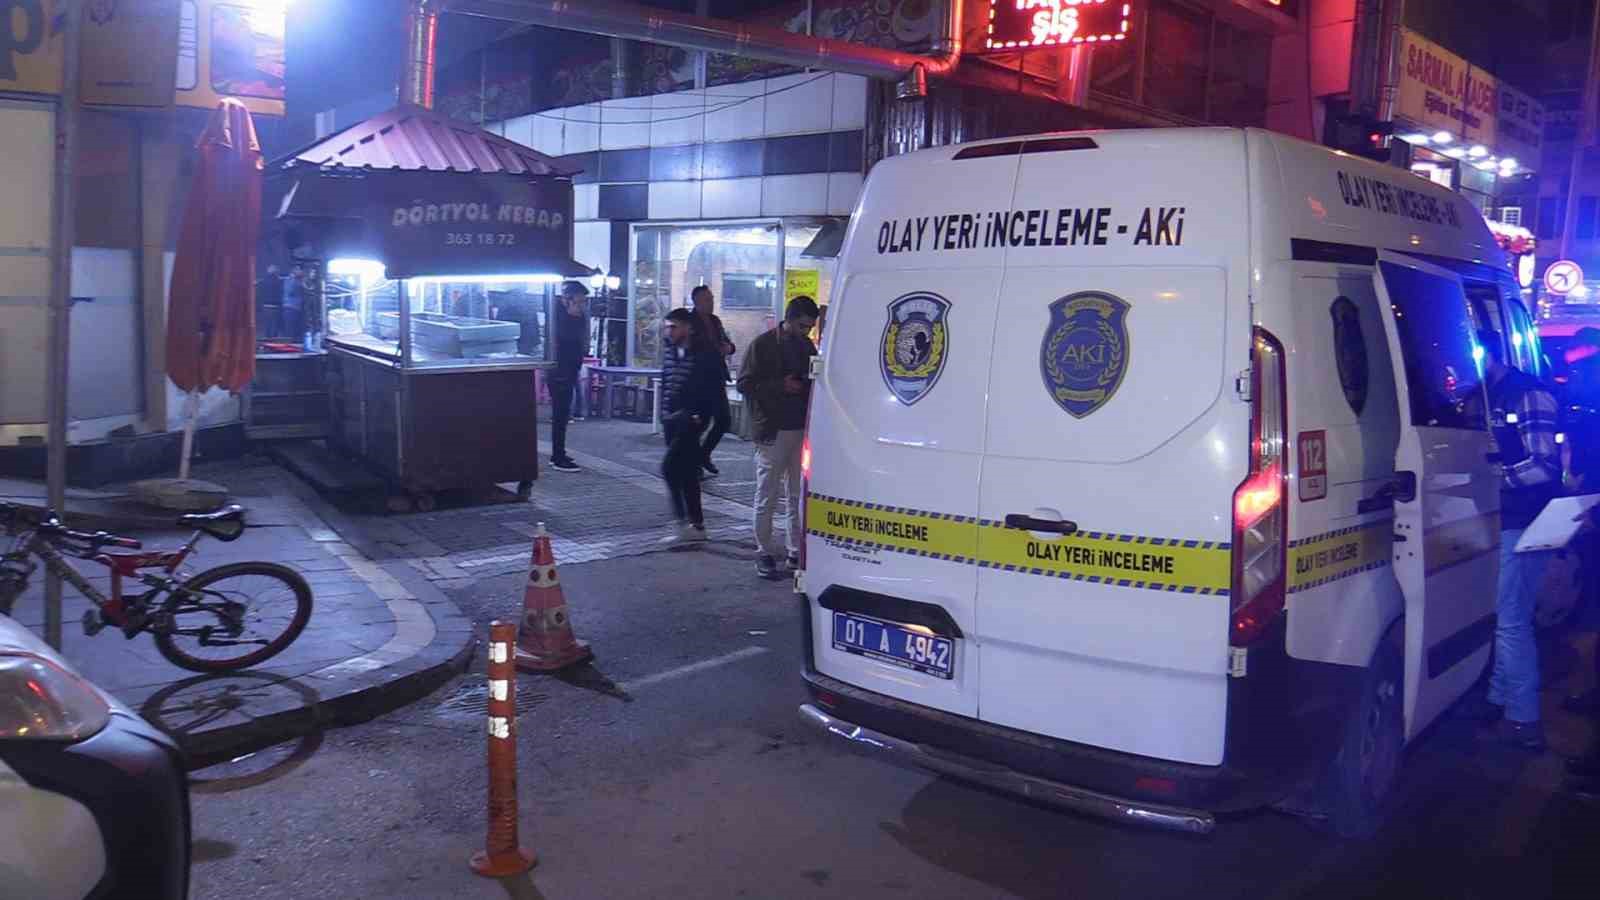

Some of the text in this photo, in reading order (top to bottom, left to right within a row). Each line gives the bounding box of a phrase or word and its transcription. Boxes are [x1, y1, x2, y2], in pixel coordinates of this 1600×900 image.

[1406, 43, 1455, 98] SARMAL
[392, 199, 564, 228] DÖRTYOL KEBAP
[447, 232, 516, 245] 363 18 72
[877, 216, 929, 254] OLAY
[1301, 438, 1324, 472] 112
[827, 510, 850, 527] OLAY
[1027, 541, 1062, 562] OLAY
[846, 619, 864, 646] 01
[880, 628, 890, 653] A
[905, 634, 949, 669] 4942
